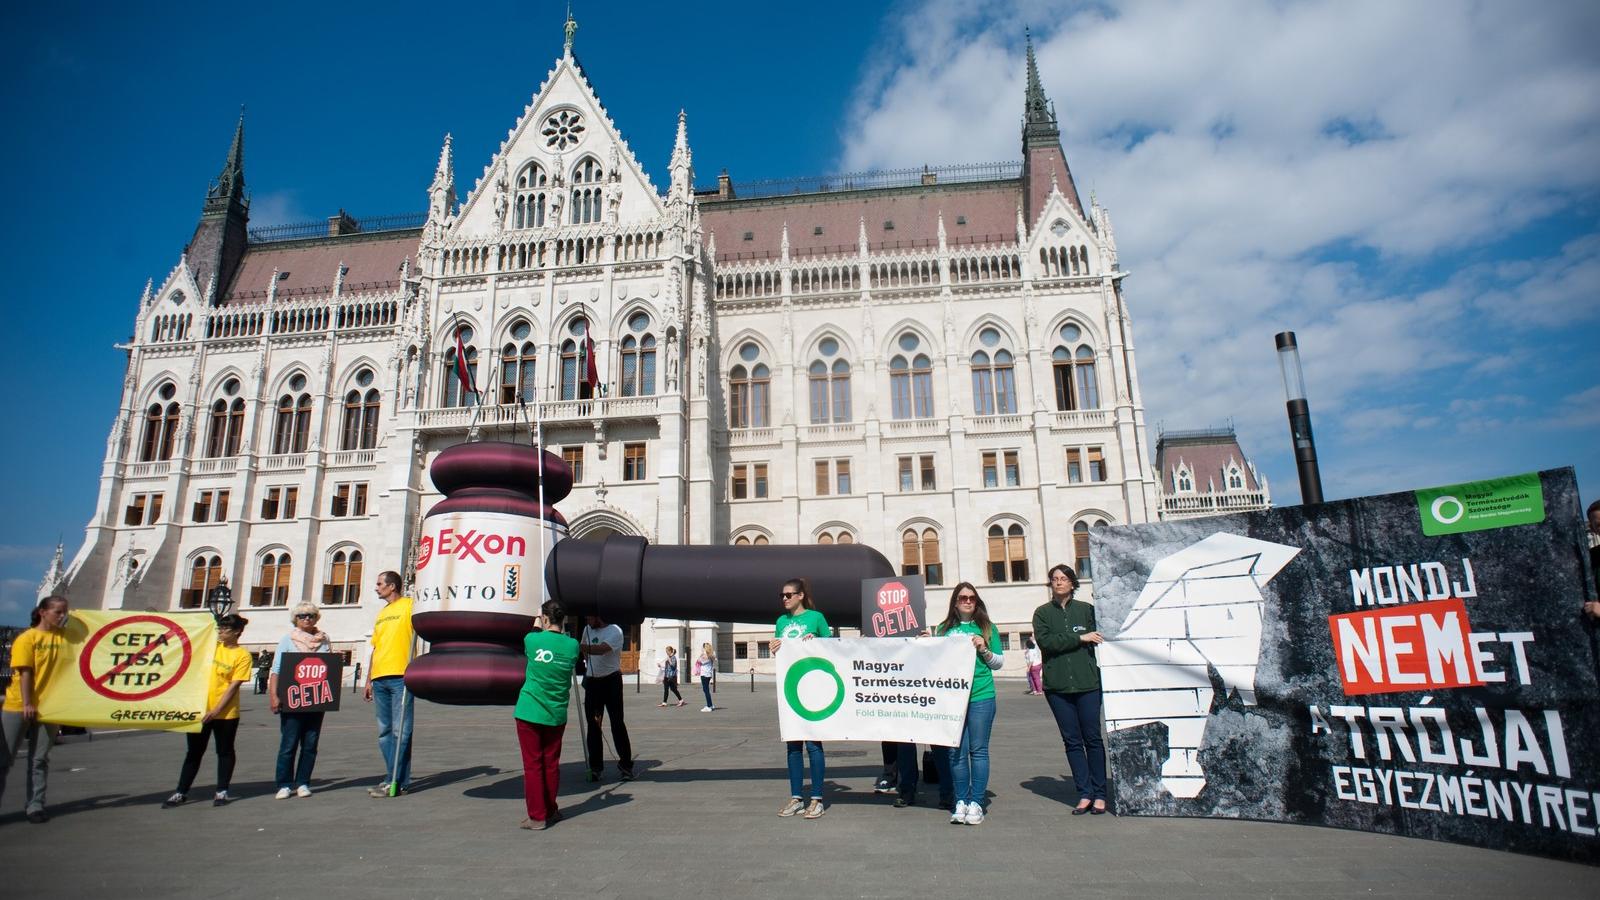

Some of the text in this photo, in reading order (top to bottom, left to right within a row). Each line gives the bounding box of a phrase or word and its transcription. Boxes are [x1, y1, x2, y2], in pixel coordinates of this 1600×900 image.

[1350, 558, 1477, 606] MONDJ
[880, 589, 907, 605] STOP
[872, 604, 919, 638] CETA
[112, 633, 168, 646] CETA
[110, 652, 164, 666] TISA
[534, 648, 554, 663] 20
[298, 664, 327, 679] STOP
[853, 660, 904, 673] Magyar
[106, 672, 161, 686] TTIP
[287, 680, 333, 709] CETA
[855, 692, 936, 707] Szövetsége
[111, 709, 201, 721] GREENPEACE
[1310, 696, 1571, 779] A TRÓJAI
